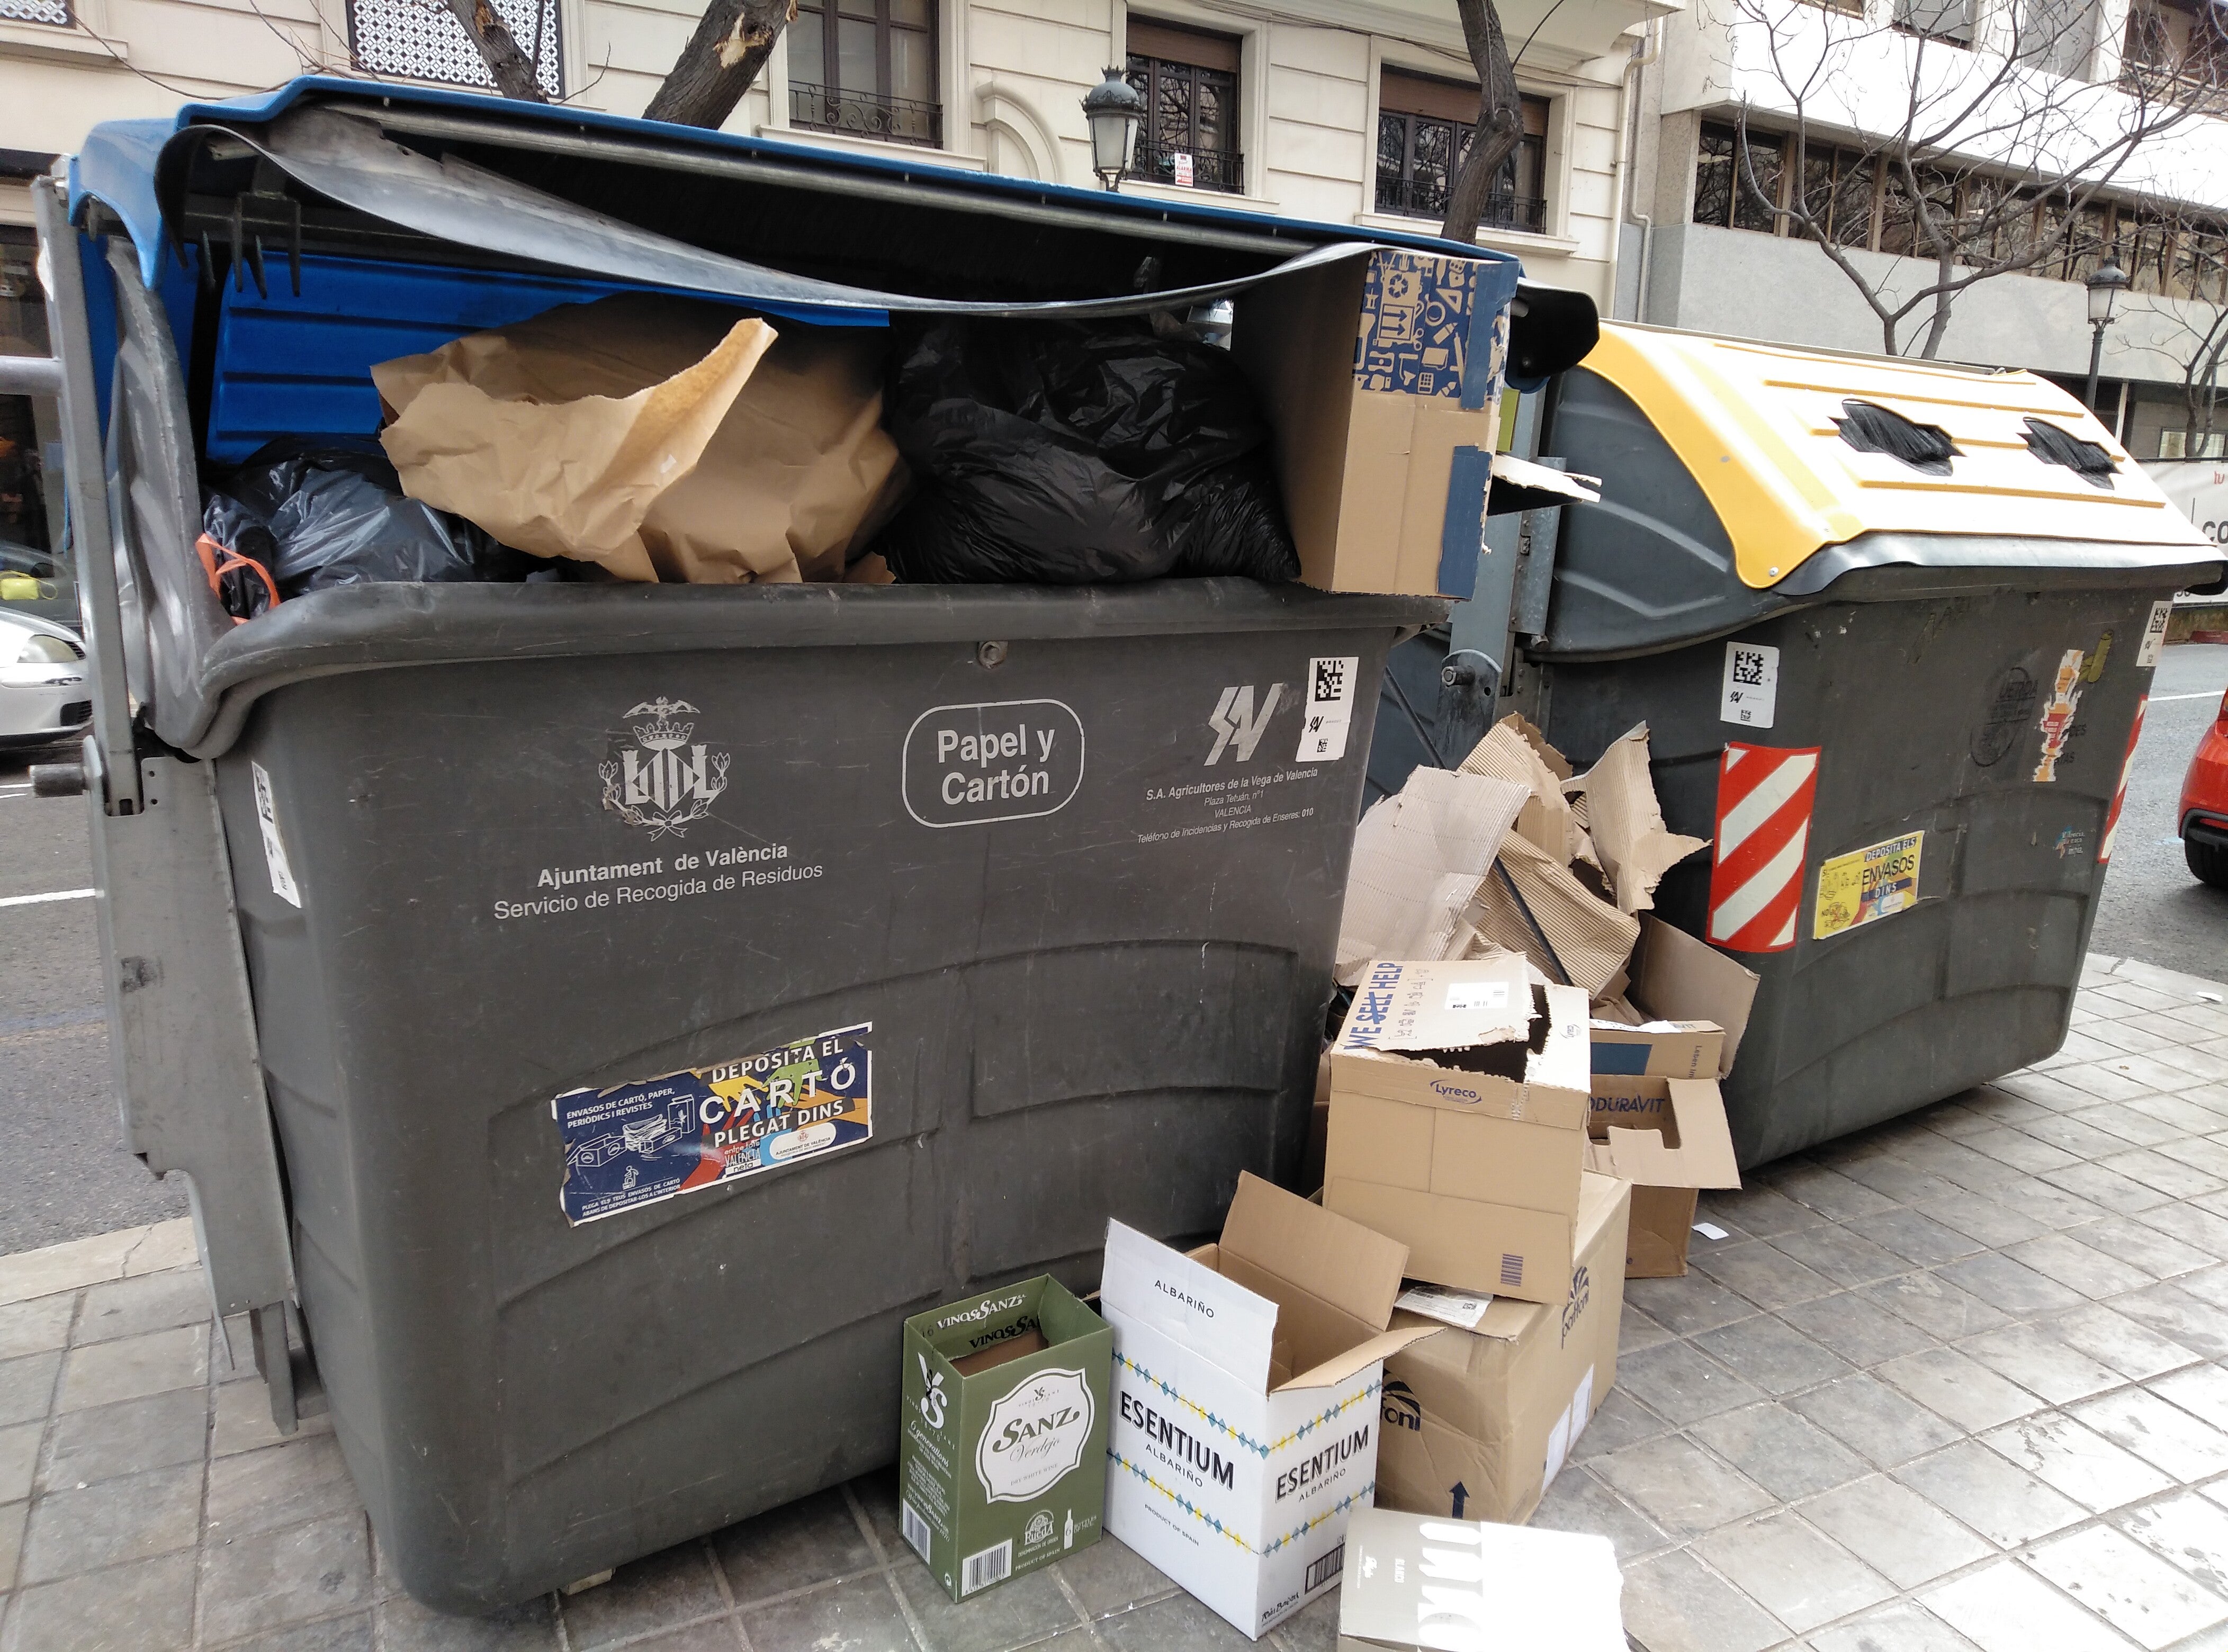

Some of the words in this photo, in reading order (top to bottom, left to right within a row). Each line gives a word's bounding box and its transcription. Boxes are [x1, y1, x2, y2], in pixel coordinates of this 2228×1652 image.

[937, 724, 1027, 768] Papel
[1036, 729, 1055, 762] y
[941, 765, 1049, 805] Cartón
[1146, 788, 1166, 801] S.A.
[1169, 780, 1225, 800] Agricultores
[1227, 779, 1239, 789] de
[1241, 777, 1248, 788] la
[1251, 775, 1271, 787] Vega
[1273, 772, 1284, 783] de
[1286, 767, 1318, 781] Valencia
[1203, 796, 1224, 806] Plaza
[1214, 804, 1252, 819] VALENCIA
[1137, 832, 1169, 843] Teléfono
[1170, 829, 1181, 839] de
[1181, 823, 1222, 837] Incidencias
[1223, 823, 1228, 832] y
[1229, 818, 1261, 829] Recogida
[1262, 814, 1271, 824] de
[1272, 811, 1300, 823] Enseres:
[1301, 807, 1314, 816] 010
[1866, 841, 1901, 862] DEPOSITA
[1902, 837, 1916, 848] ELS
[537, 856, 663, 890] Ajuntament
[674, 854, 699, 870] de
[705, 844, 788, 867] València
[1862, 854, 1915, 886] ENVASOS
[493, 898, 578, 920] Servicio
[584, 891, 610, 909] de
[616, 877, 707, 902] Recogida
[713, 875, 736, 892] de
[742, 863, 823, 888] Residuos
[1874, 883, 1897, 898] DINS
[1368, 963, 1404, 990] HELP
[1355, 991, 1394, 1025] SELL
[1345, 1027, 1382, 1051] WE
[712, 1045, 816, 1083] DEPOSITA
[822, 1038, 843, 1057] EL
[567, 1103, 605, 1119] ENVASOS
[605, 1101, 617, 1110] DE
[648, 1088, 676, 1100] PAPER,
[1435, 1083, 1477, 1099] Lyreco
[1595, 1094, 1665, 1113] DURAVIT
[567, 1112, 610, 1129] PERIÒDICS
[615, 1102, 653, 1117] REVISTES
[714, 1114, 792, 1148] PLEGAT
[797, 1099, 844, 1126] DINS
[724, 1144, 744, 1155] entre
[775, 1144, 804, 1156] AJUNTAMENT
[733, 1162, 753, 1172] neta
[581, 1202, 599, 1211] PLEGA
[627, 1186, 652, 1197] ENVASOS
[1154, 1279, 1215, 1318] ALBARIÑO
[992, 1406, 1081, 1453] SANZ
[1119, 1390, 1235, 1491] ESENTIUM
[1009, 1437, 1059, 1462] Verdejo
[1275, 1424, 1369, 1504] ESENTIUM
[1022, 1471, 1042, 1481] WHITE
[1043, 1463, 1058, 1473] WINE
[1145, 1443, 1204, 1488] ALBARIÑO
[1298, 1468, 1346, 1503] ALBARIÑO
[1144, 1503, 1172, 1527] PRODUCT
[1172, 1523, 1181, 1533] OF
[1181, 1529, 1200, 1547] SPAIN
[1015, 1557, 1039, 1571] PRODUCT
[1046, 1548, 1061, 1558] SPAIN
[1394, 1558, 1406, 1583] BLANCO
